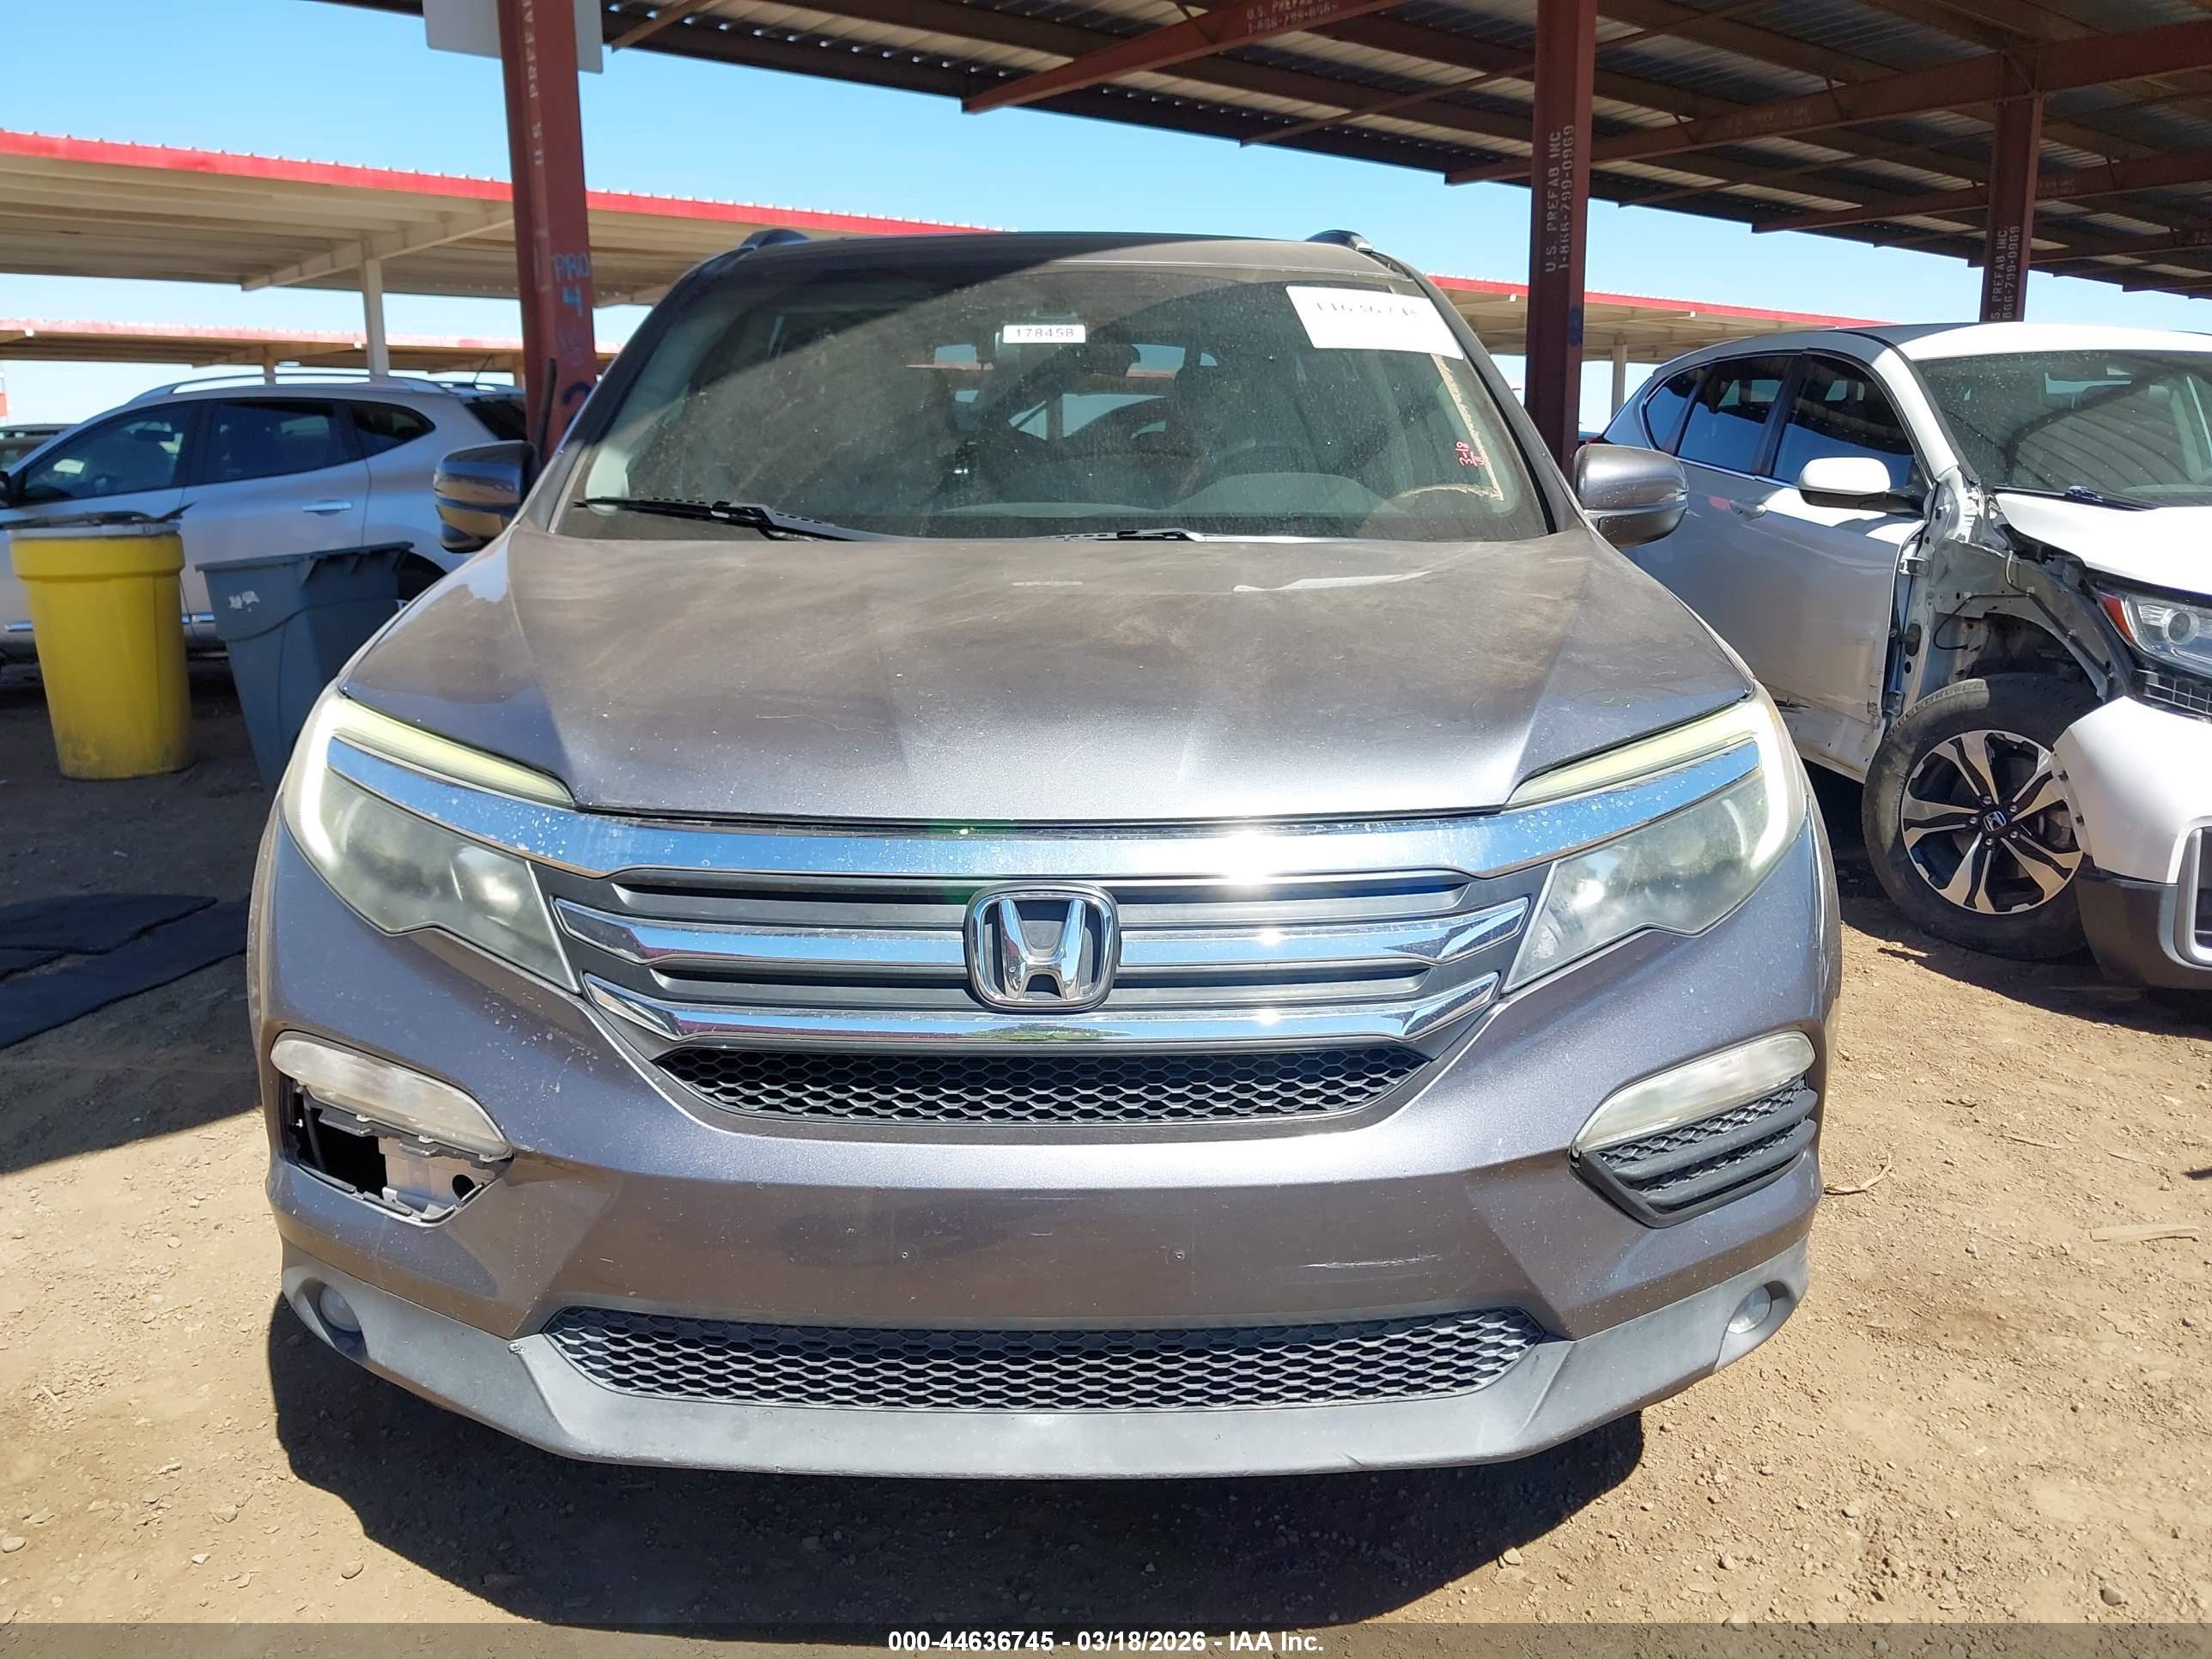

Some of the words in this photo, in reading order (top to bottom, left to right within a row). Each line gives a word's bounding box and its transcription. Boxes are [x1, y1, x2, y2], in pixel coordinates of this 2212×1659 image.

[1547, 166, 1559, 232] PREFAB
[1559, 125, 1574, 270] 1-866-799-0969
[1992, 254, 2006, 302] PREFAB
[2002, 225, 2021, 319] 866-799-0969
[1017, 328, 1073, 337] 178458
